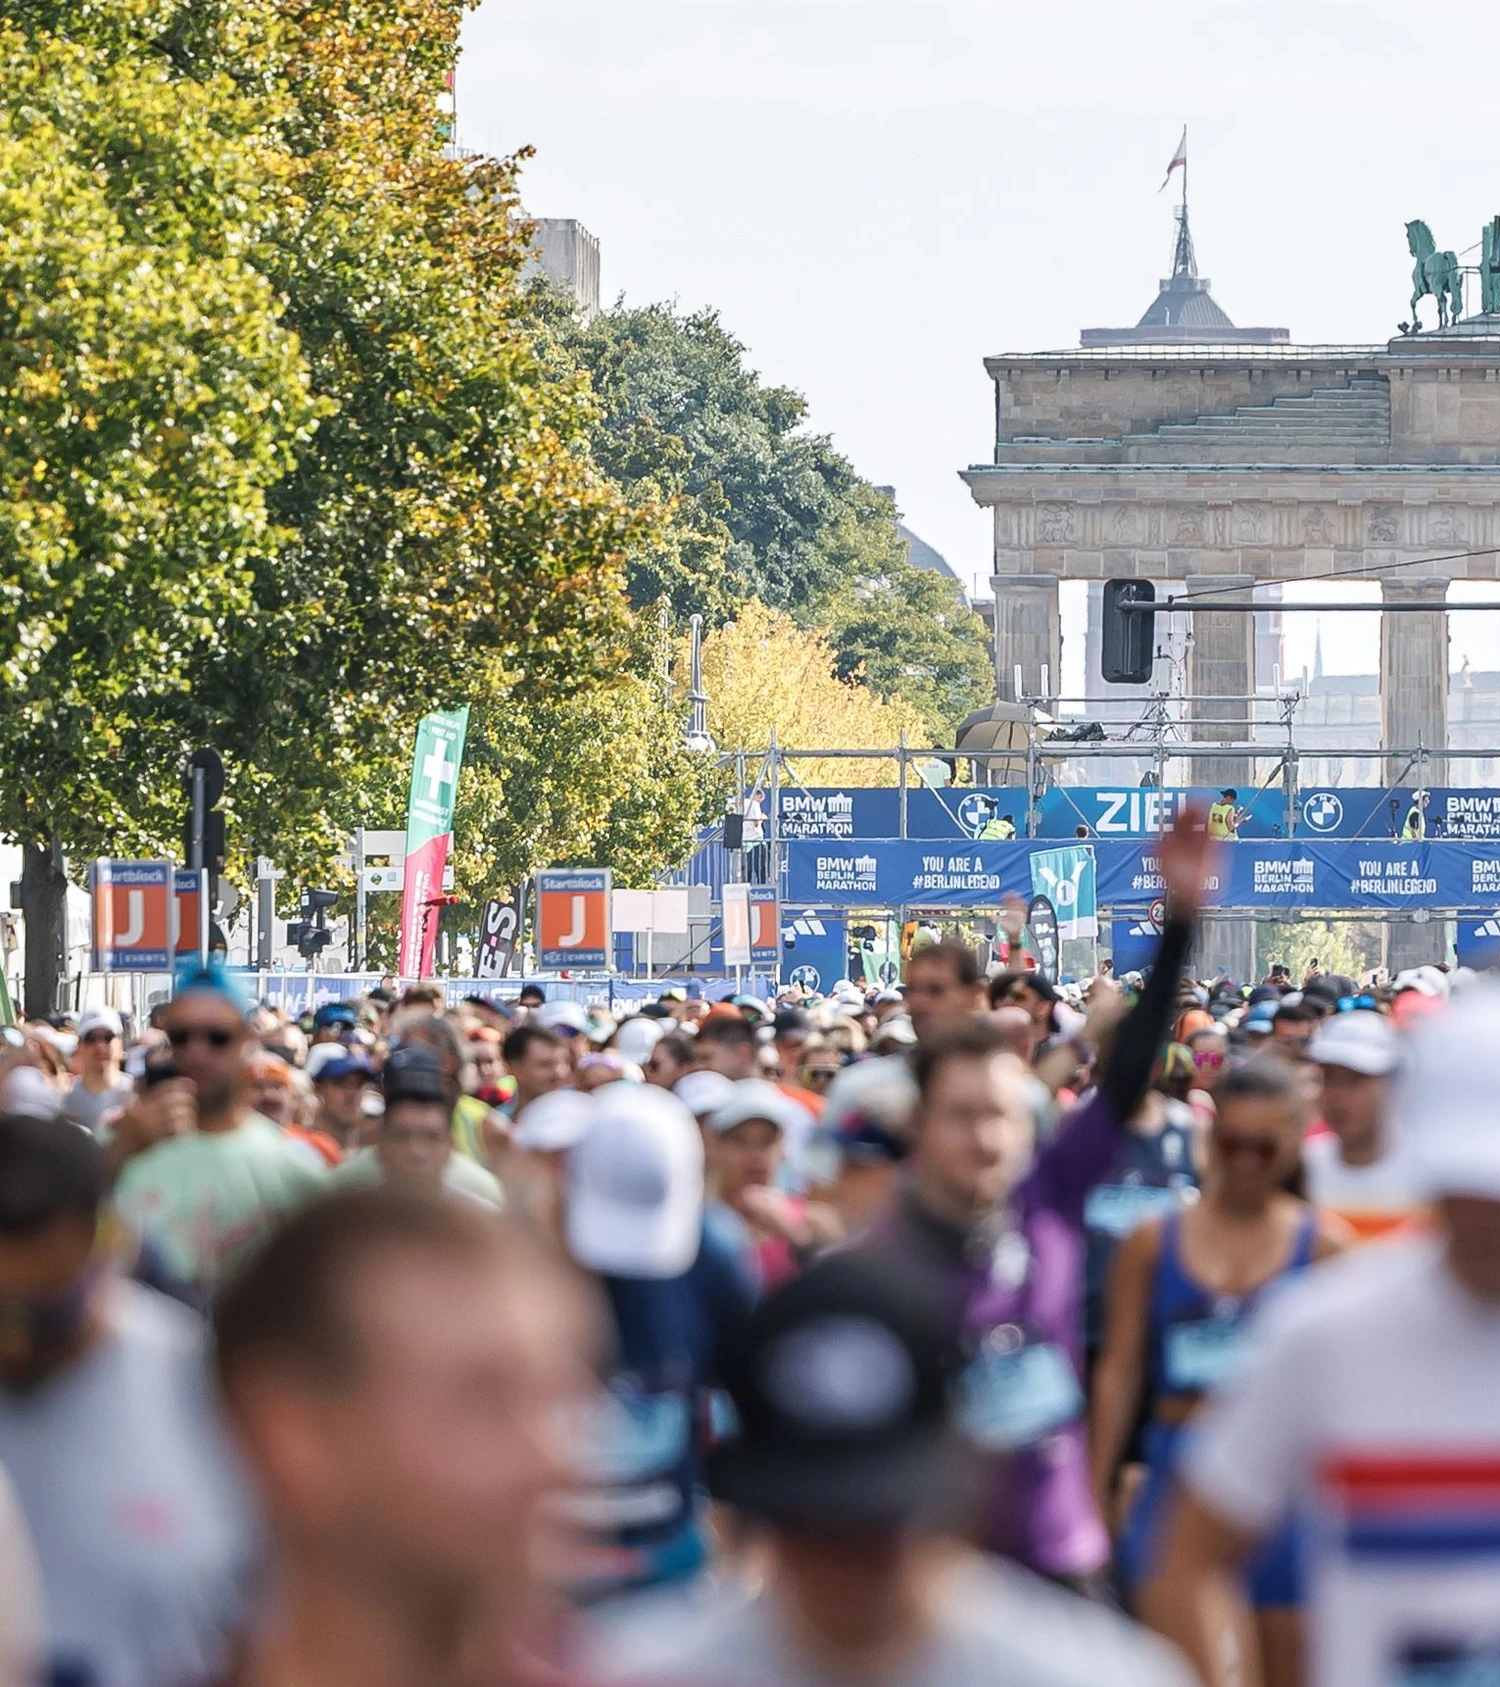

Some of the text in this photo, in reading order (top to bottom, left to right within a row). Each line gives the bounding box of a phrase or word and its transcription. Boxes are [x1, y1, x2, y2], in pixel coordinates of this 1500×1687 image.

[782, 796, 827, 812] BMW
[1447, 797, 1493, 812] BMW
[783, 823, 853, 835] MARATHON
[816, 857, 855, 871] BMW
[922, 856, 983, 872] YOU ARE A
[1254, 861, 1291, 874] BMW
[1359, 860, 1419, 876] YOU ARE A
[816, 871, 855, 880] BERLIN
[912, 874, 1000, 889] #BERLINLEGEND
[1254, 874, 1292, 883] BERLIN
[543, 878, 603, 889] Startblock
[816, 881, 877, 891] MARATHON
[1254, 883, 1314, 893] MARATHON
[1350, 879, 1437, 894] #BERLINLEGEND
[115, 889, 144, 947] J
[559, 896, 586, 946] J
[752, 950, 776, 958] VENTS
